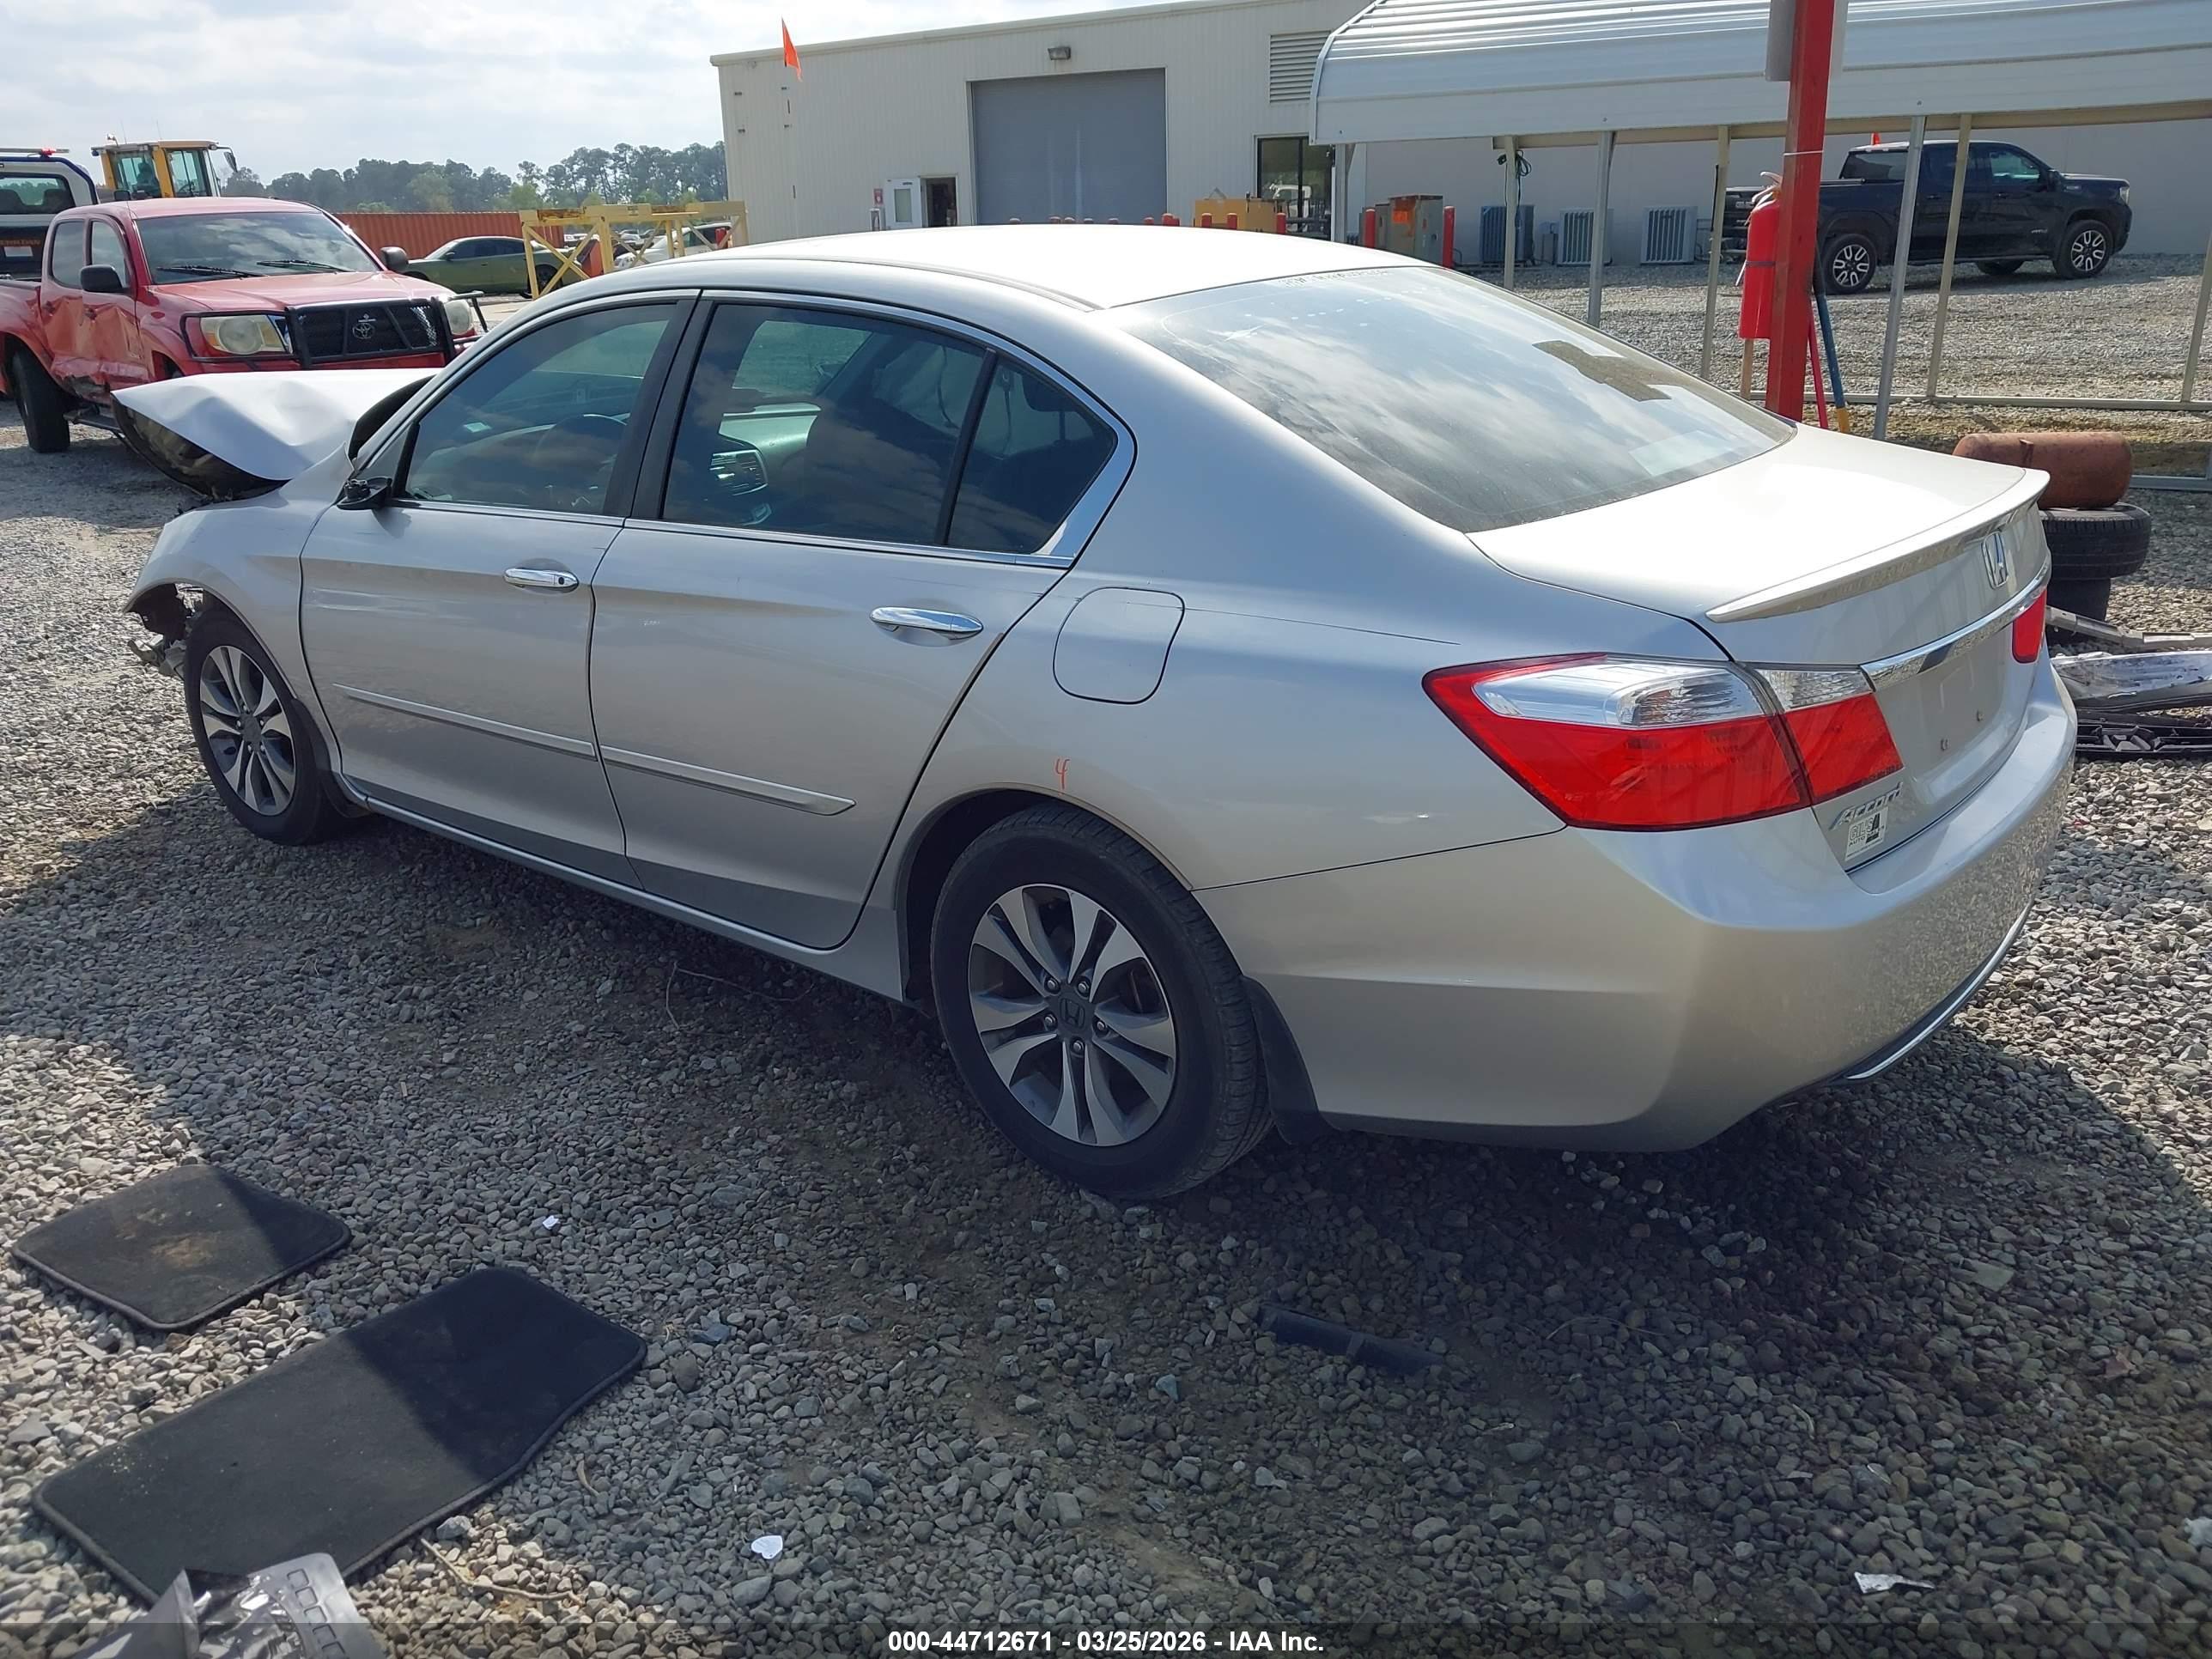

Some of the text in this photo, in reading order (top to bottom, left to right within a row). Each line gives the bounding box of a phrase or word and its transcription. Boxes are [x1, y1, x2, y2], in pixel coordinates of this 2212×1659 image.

[1055, 758, 1071, 790] 4
[1828, 781, 1903, 830] Accord
[1849, 836, 1866, 847] AUTO
